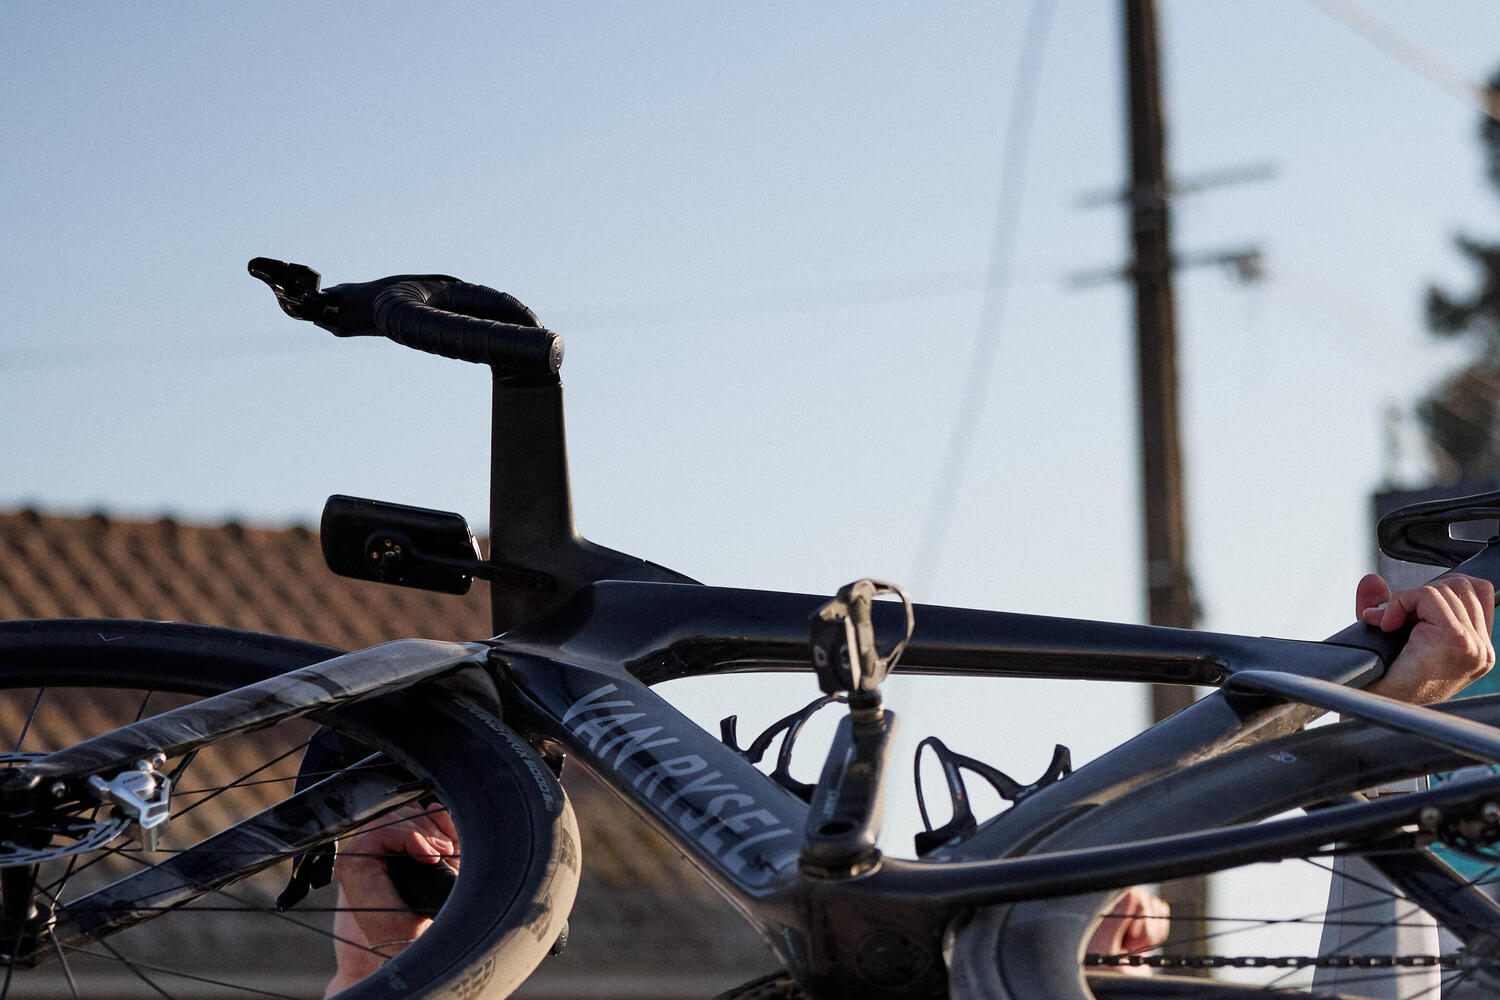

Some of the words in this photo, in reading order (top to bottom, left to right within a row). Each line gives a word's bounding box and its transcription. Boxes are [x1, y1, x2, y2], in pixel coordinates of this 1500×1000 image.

[523, 759, 551, 793] 5000
[562, 683, 680, 770] VAN
[633, 754, 793, 875] RYSEL
